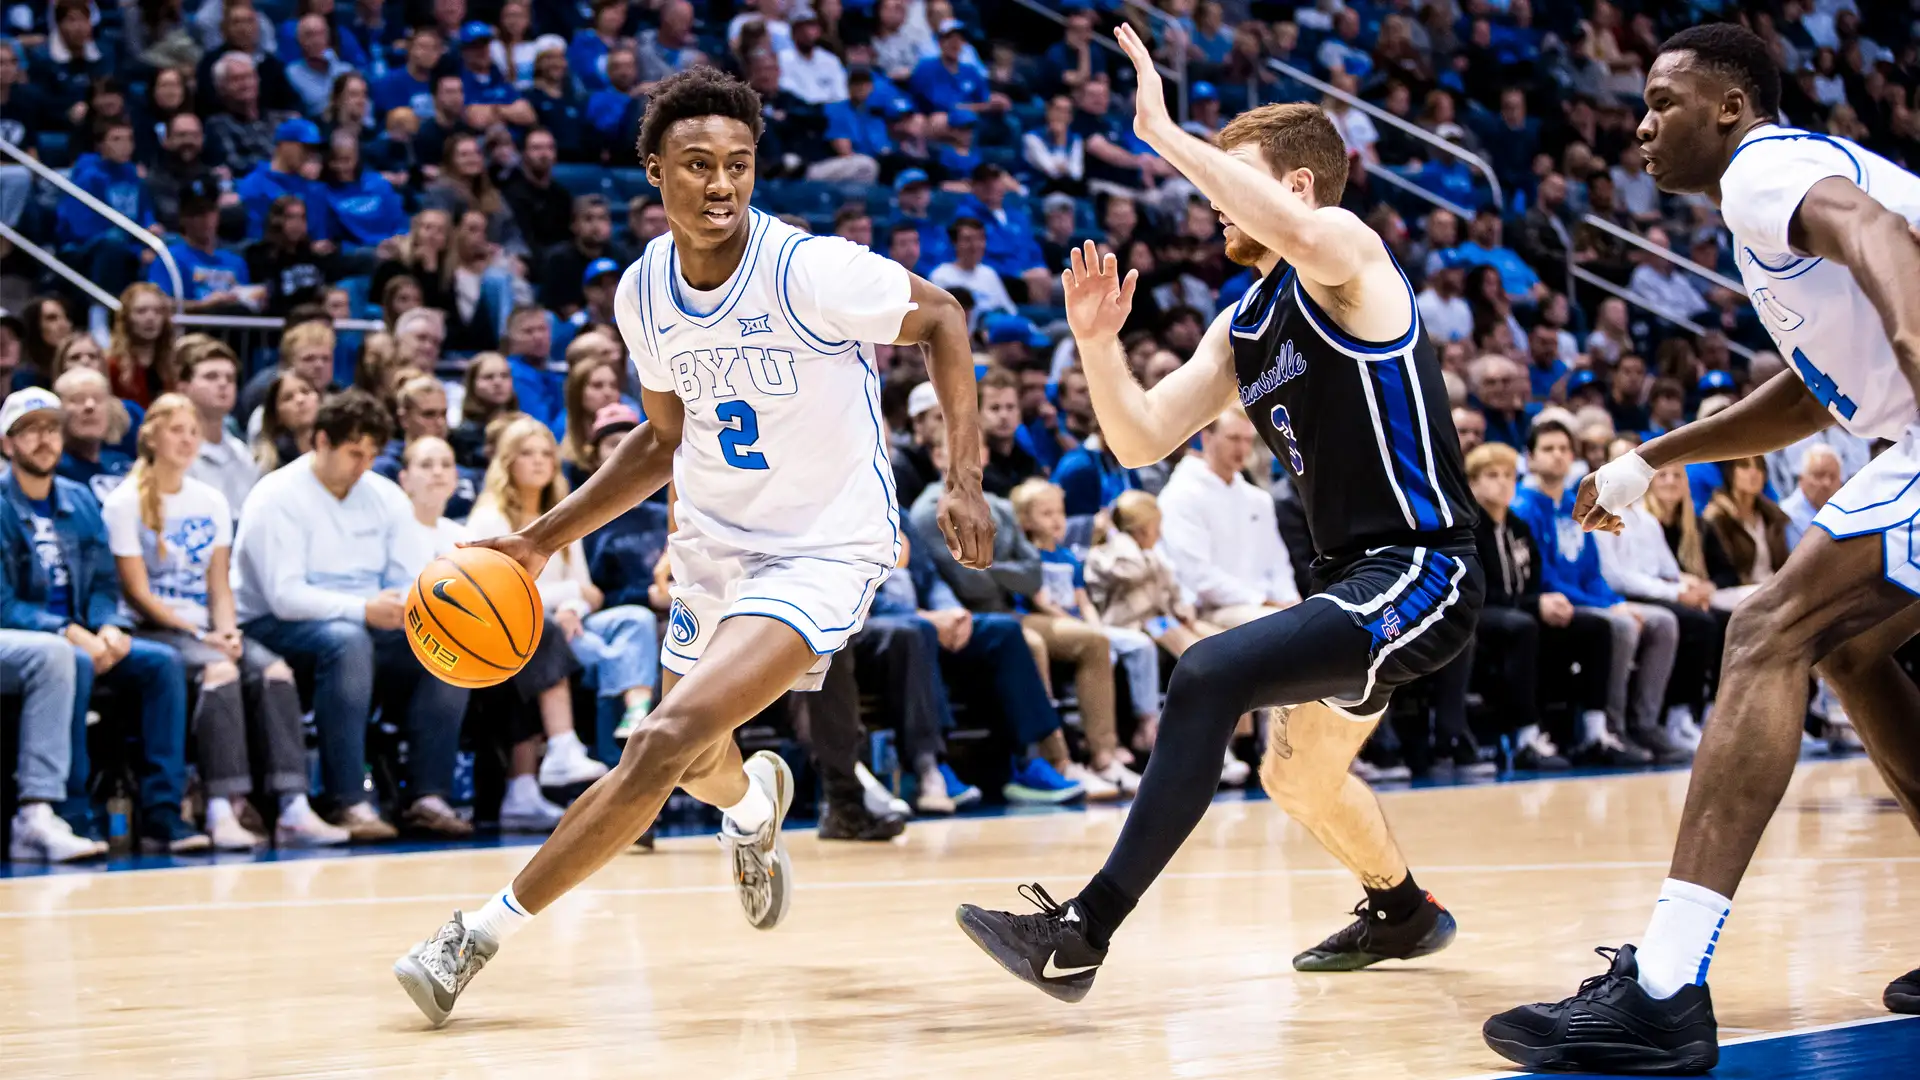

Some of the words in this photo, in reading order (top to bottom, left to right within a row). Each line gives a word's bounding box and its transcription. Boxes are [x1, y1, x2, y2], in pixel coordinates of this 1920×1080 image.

[671, 346, 798, 402] BYU
[1792, 346, 1858, 421] 4
[715, 400, 770, 470] 2
[1270, 404, 1304, 476] 3
[408, 604, 458, 668] ELITE
